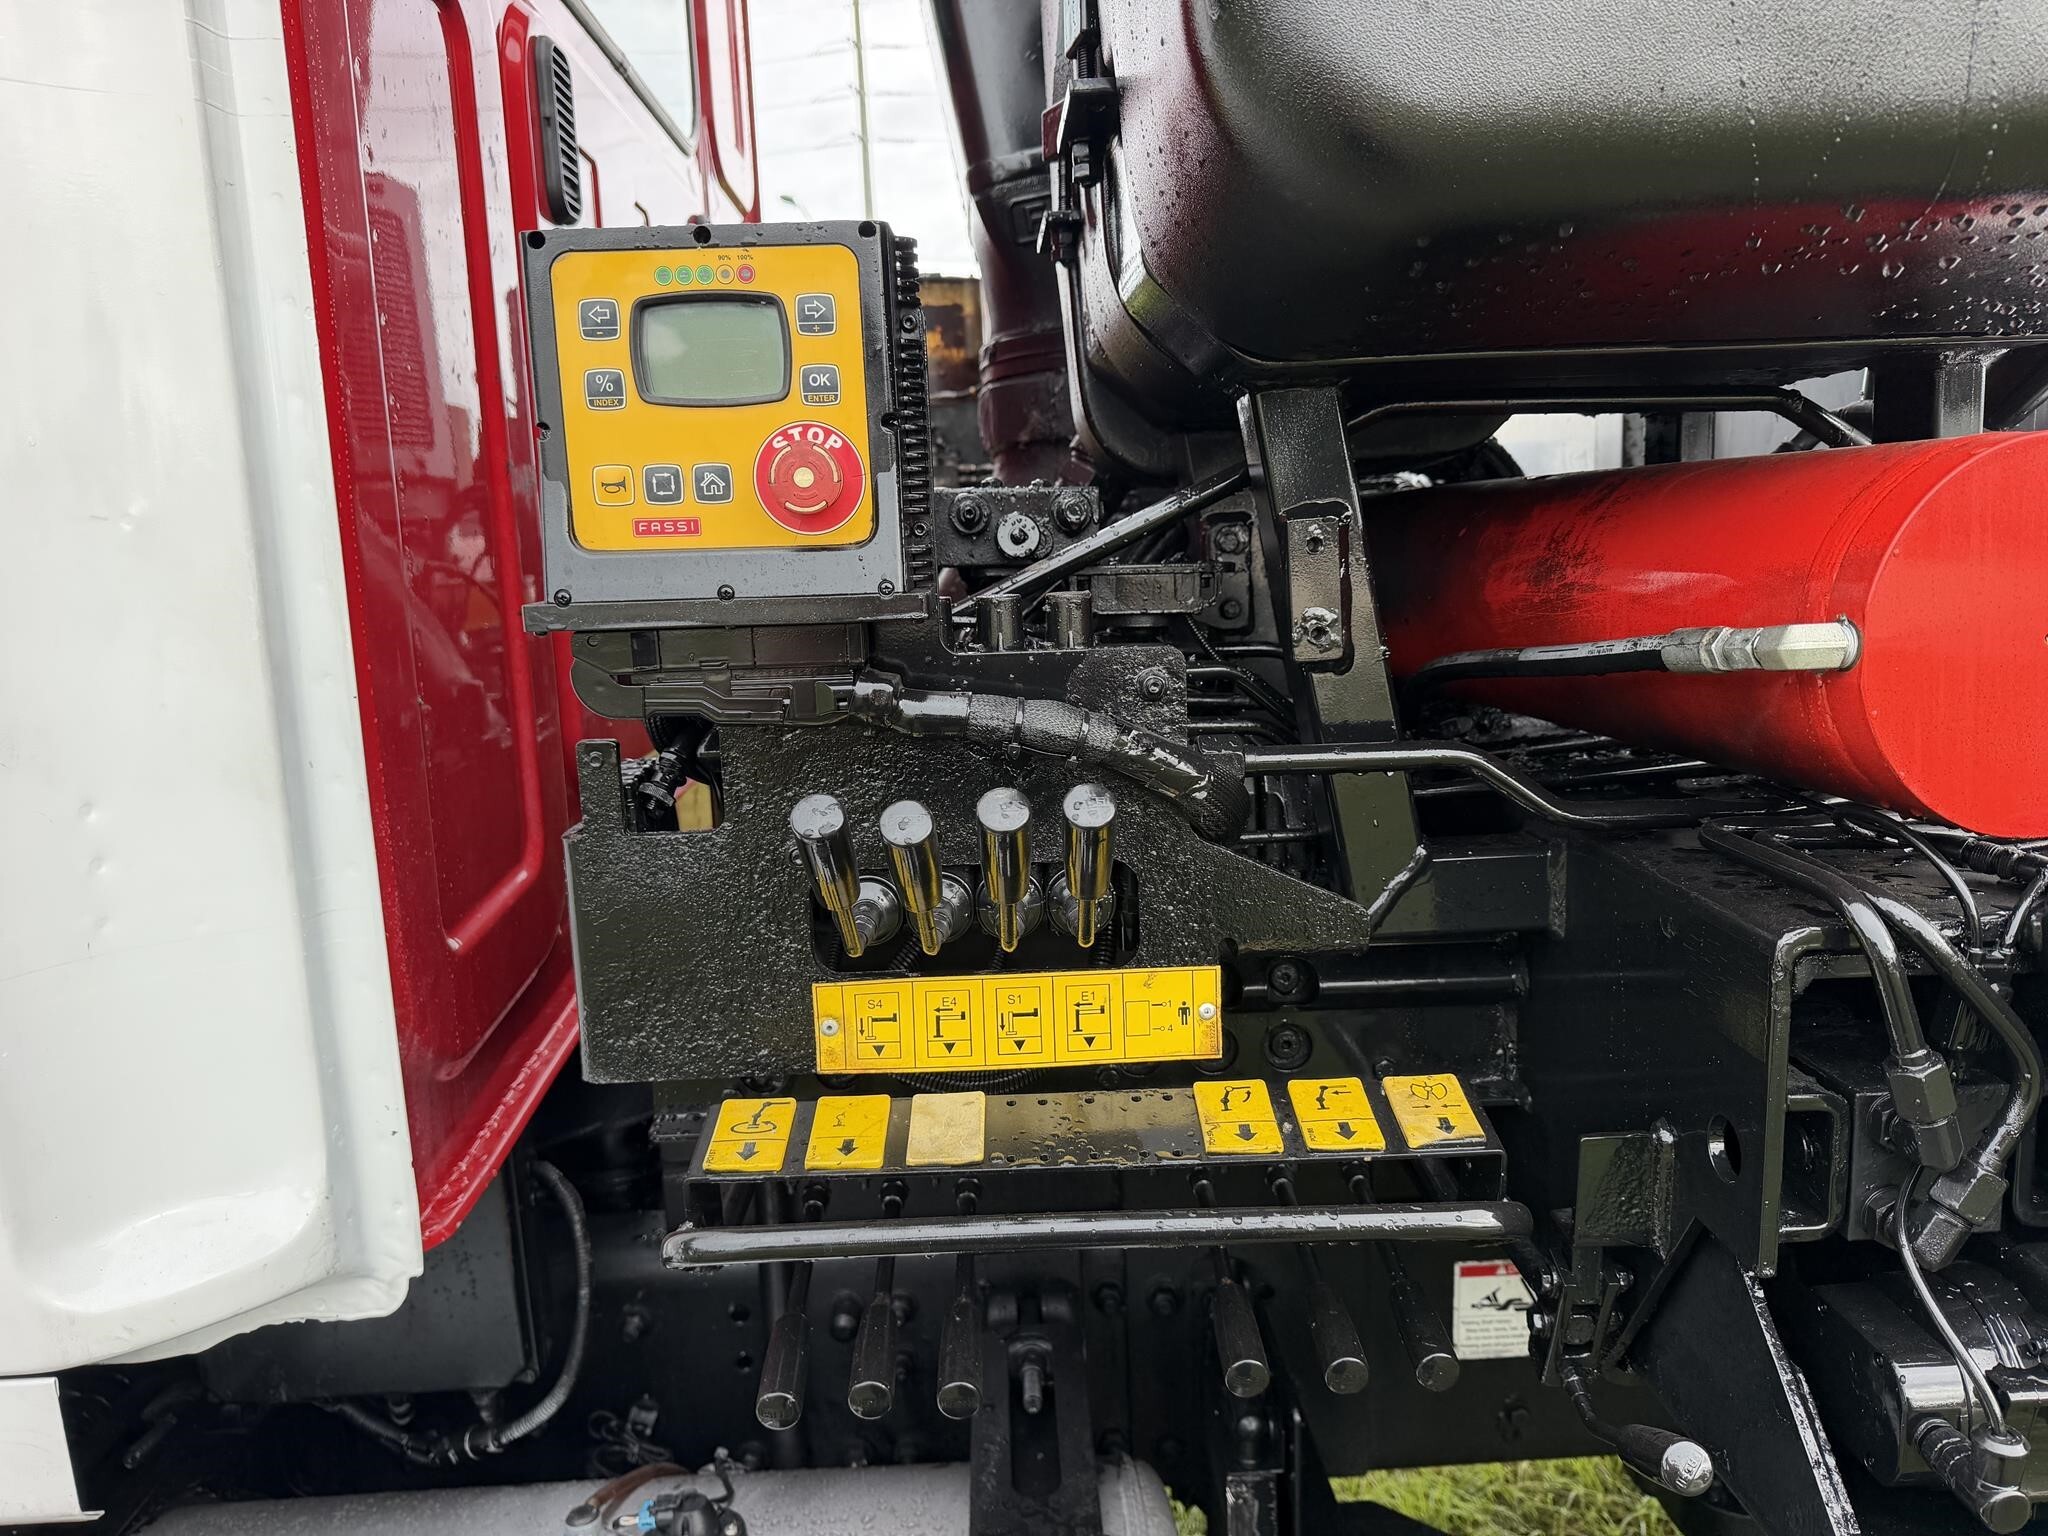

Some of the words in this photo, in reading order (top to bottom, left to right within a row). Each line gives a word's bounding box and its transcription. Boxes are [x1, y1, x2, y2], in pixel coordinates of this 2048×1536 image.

[595, 373, 614, 393] %
[808, 372, 830, 387] OK
[593, 397, 620, 407] INDEX
[807, 393, 836, 403] ENTER
[772, 426, 843, 451] STOP
[638, 521, 696, 534] FASSI
[1007, 994, 1022, 1005] S1
[1081, 991, 1095, 1001] E1
[867, 999, 883, 1010] S4
[942, 997, 957, 1007] E4
